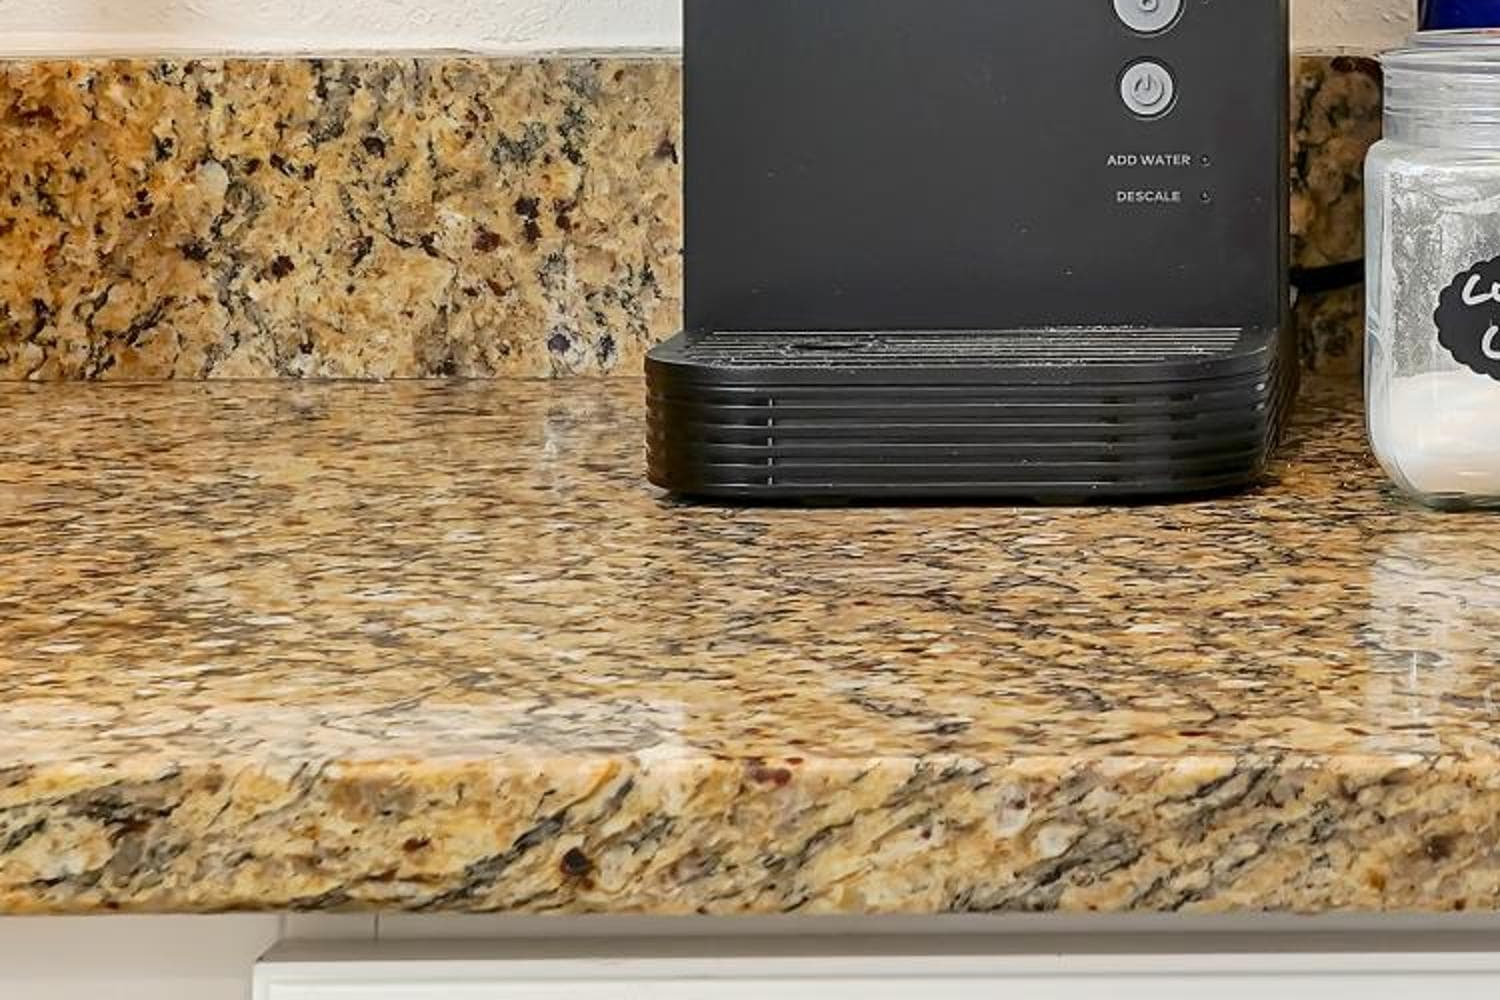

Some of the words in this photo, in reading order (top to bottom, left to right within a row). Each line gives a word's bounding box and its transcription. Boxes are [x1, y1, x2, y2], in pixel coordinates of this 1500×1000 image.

[1107, 154, 1137, 166] ADD
[1139, 154, 1191, 166] WATER
[1117, 191, 1181, 203] DESCALE
